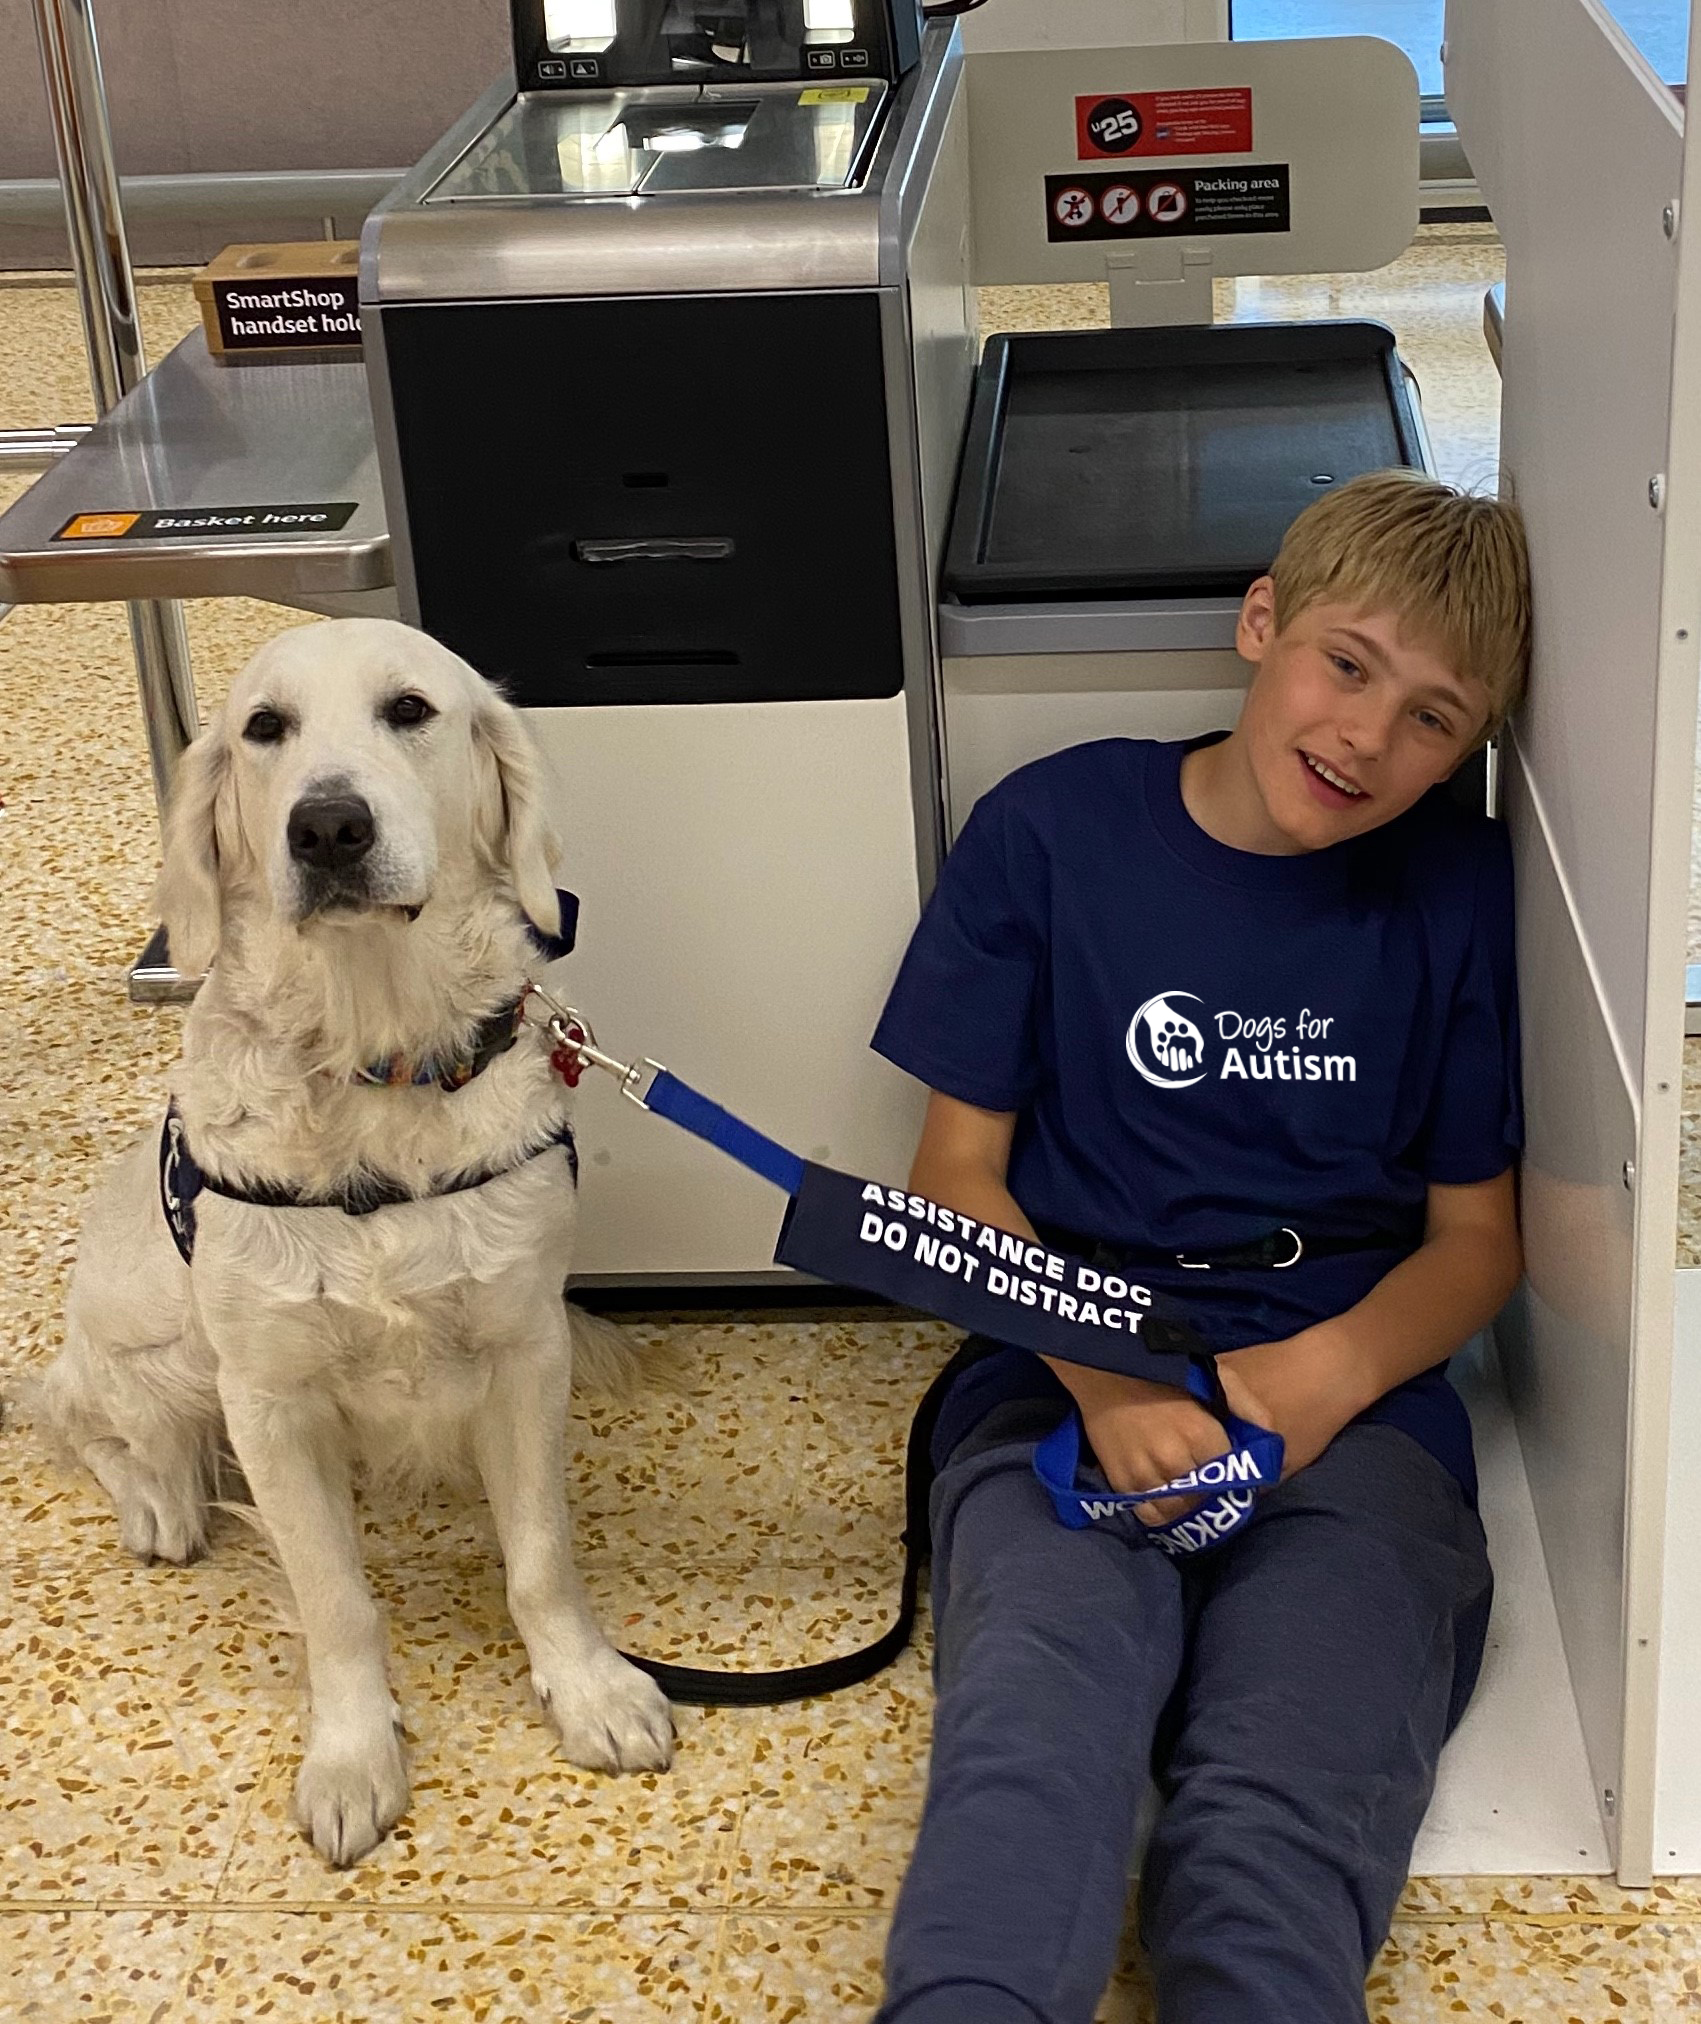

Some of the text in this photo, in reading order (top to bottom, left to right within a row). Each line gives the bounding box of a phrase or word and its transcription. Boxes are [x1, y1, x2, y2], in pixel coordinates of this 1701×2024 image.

[1194, 178, 1280, 192] Packing area
[225, 289, 345, 310] SmartShop
[230, 315, 318, 335] handset
[154, 512, 328, 529] Basket here
[1214, 1008, 1334, 1052] Dogs for
[1220, 1046, 1356, 1082] Autism
[861, 1182, 1152, 1306] ASSISTANCE DOG
[860, 1212, 1144, 1334] DO NOT DISTRACT
